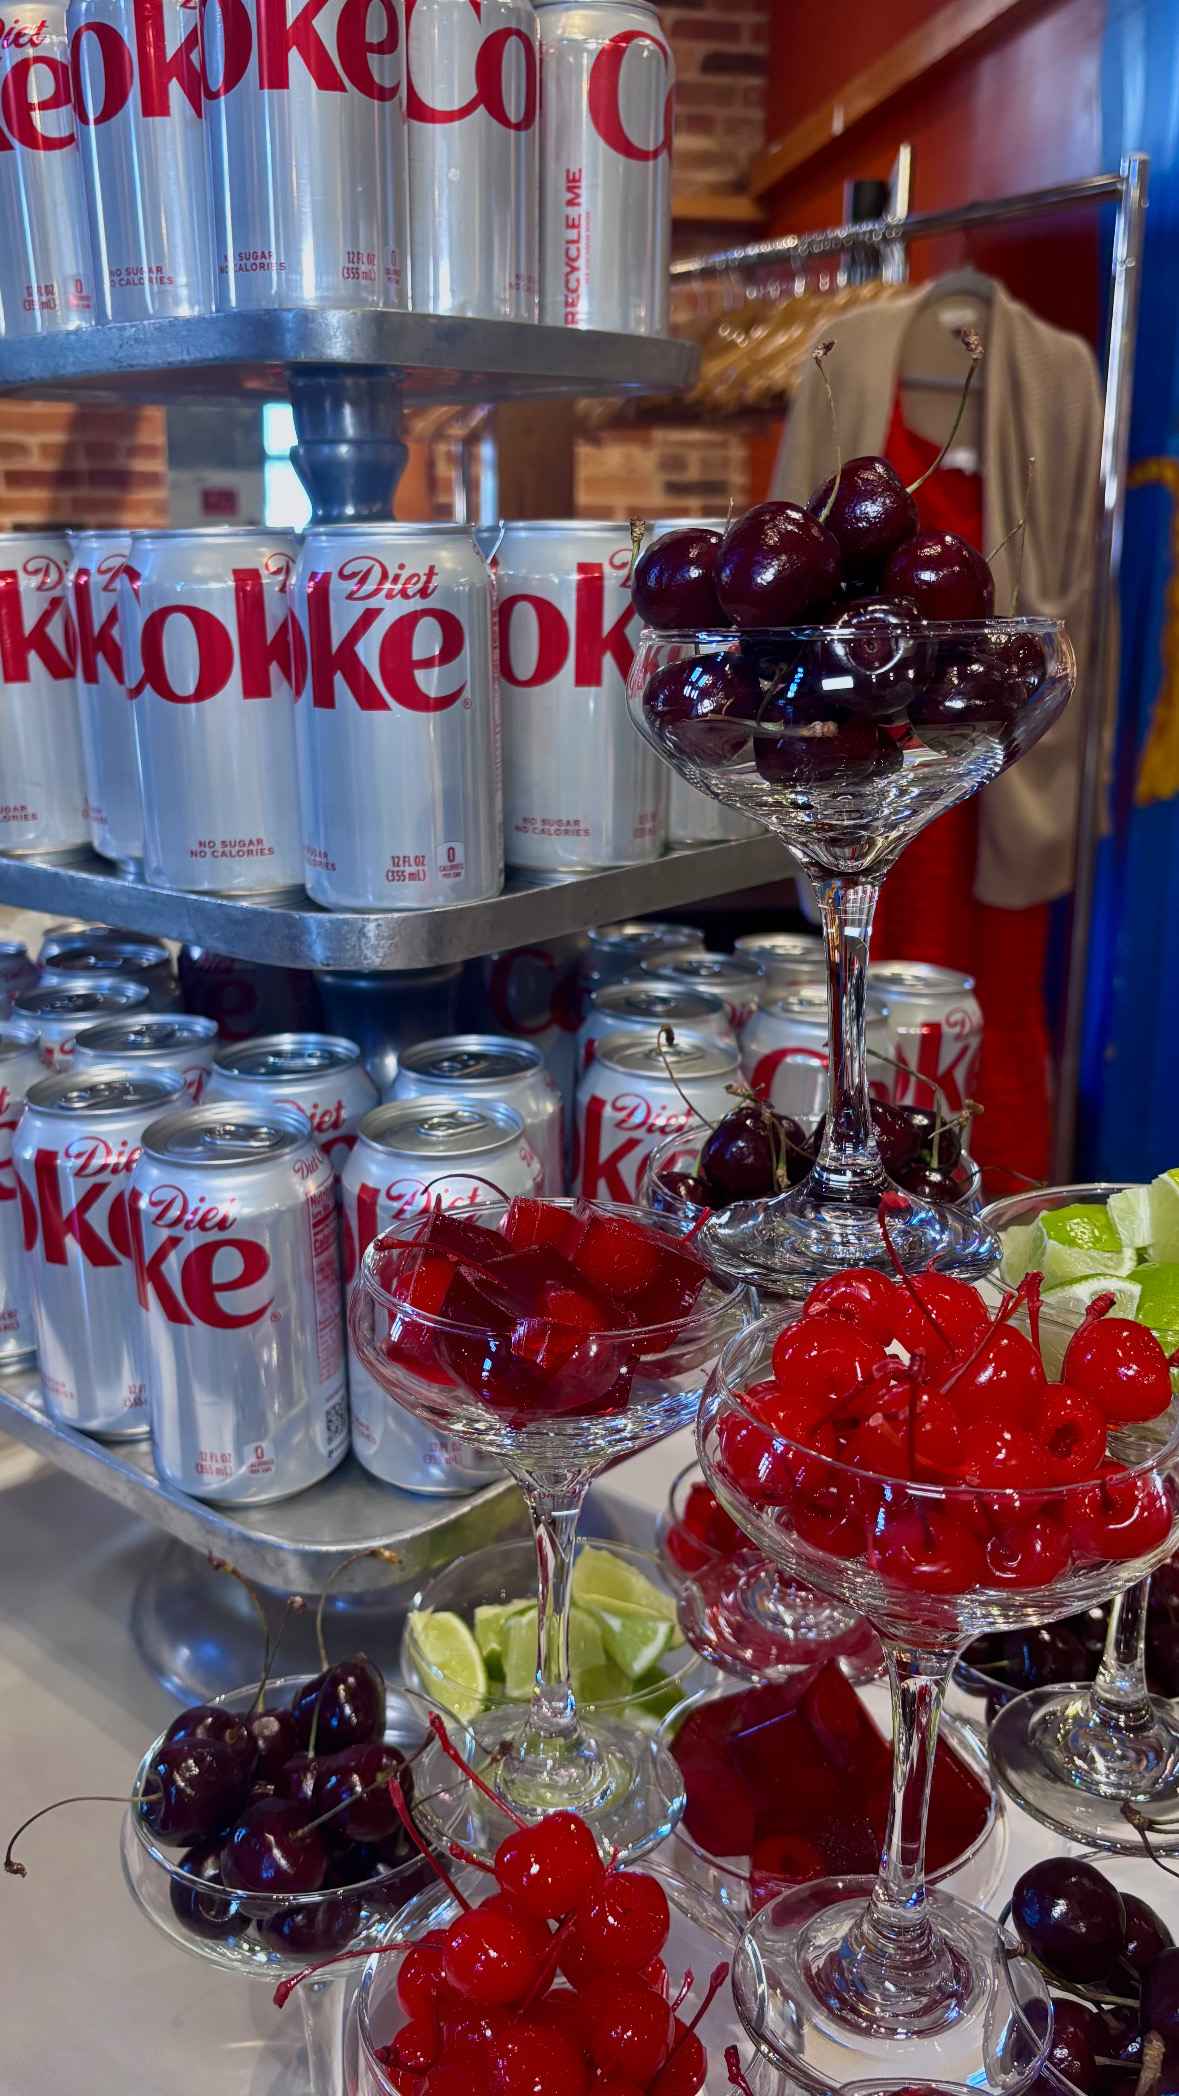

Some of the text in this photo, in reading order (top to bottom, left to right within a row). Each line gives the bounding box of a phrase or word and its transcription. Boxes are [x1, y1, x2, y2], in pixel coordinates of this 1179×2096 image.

[0, 55, 76, 151] e
[564, 168, 583, 325] RECYCLE ME
[238, 251, 275, 261] SUGAR
[346, 251, 376, 266] 12 FL OZ
[338, 556, 439, 601] Diet
[293, 571, 468, 713] ke
[541, 818, 581, 828] SUGAR
[531, 828, 590, 837] CALORIES
[198, 838, 264, 849] NO SUGAR
[190, 848, 275, 859] NO CALORIES
[391, 855, 426, 868] 12 FL OZ
[386, 868, 427, 882] (355 mL)
[611, 1092, 695, 1136] Diet
